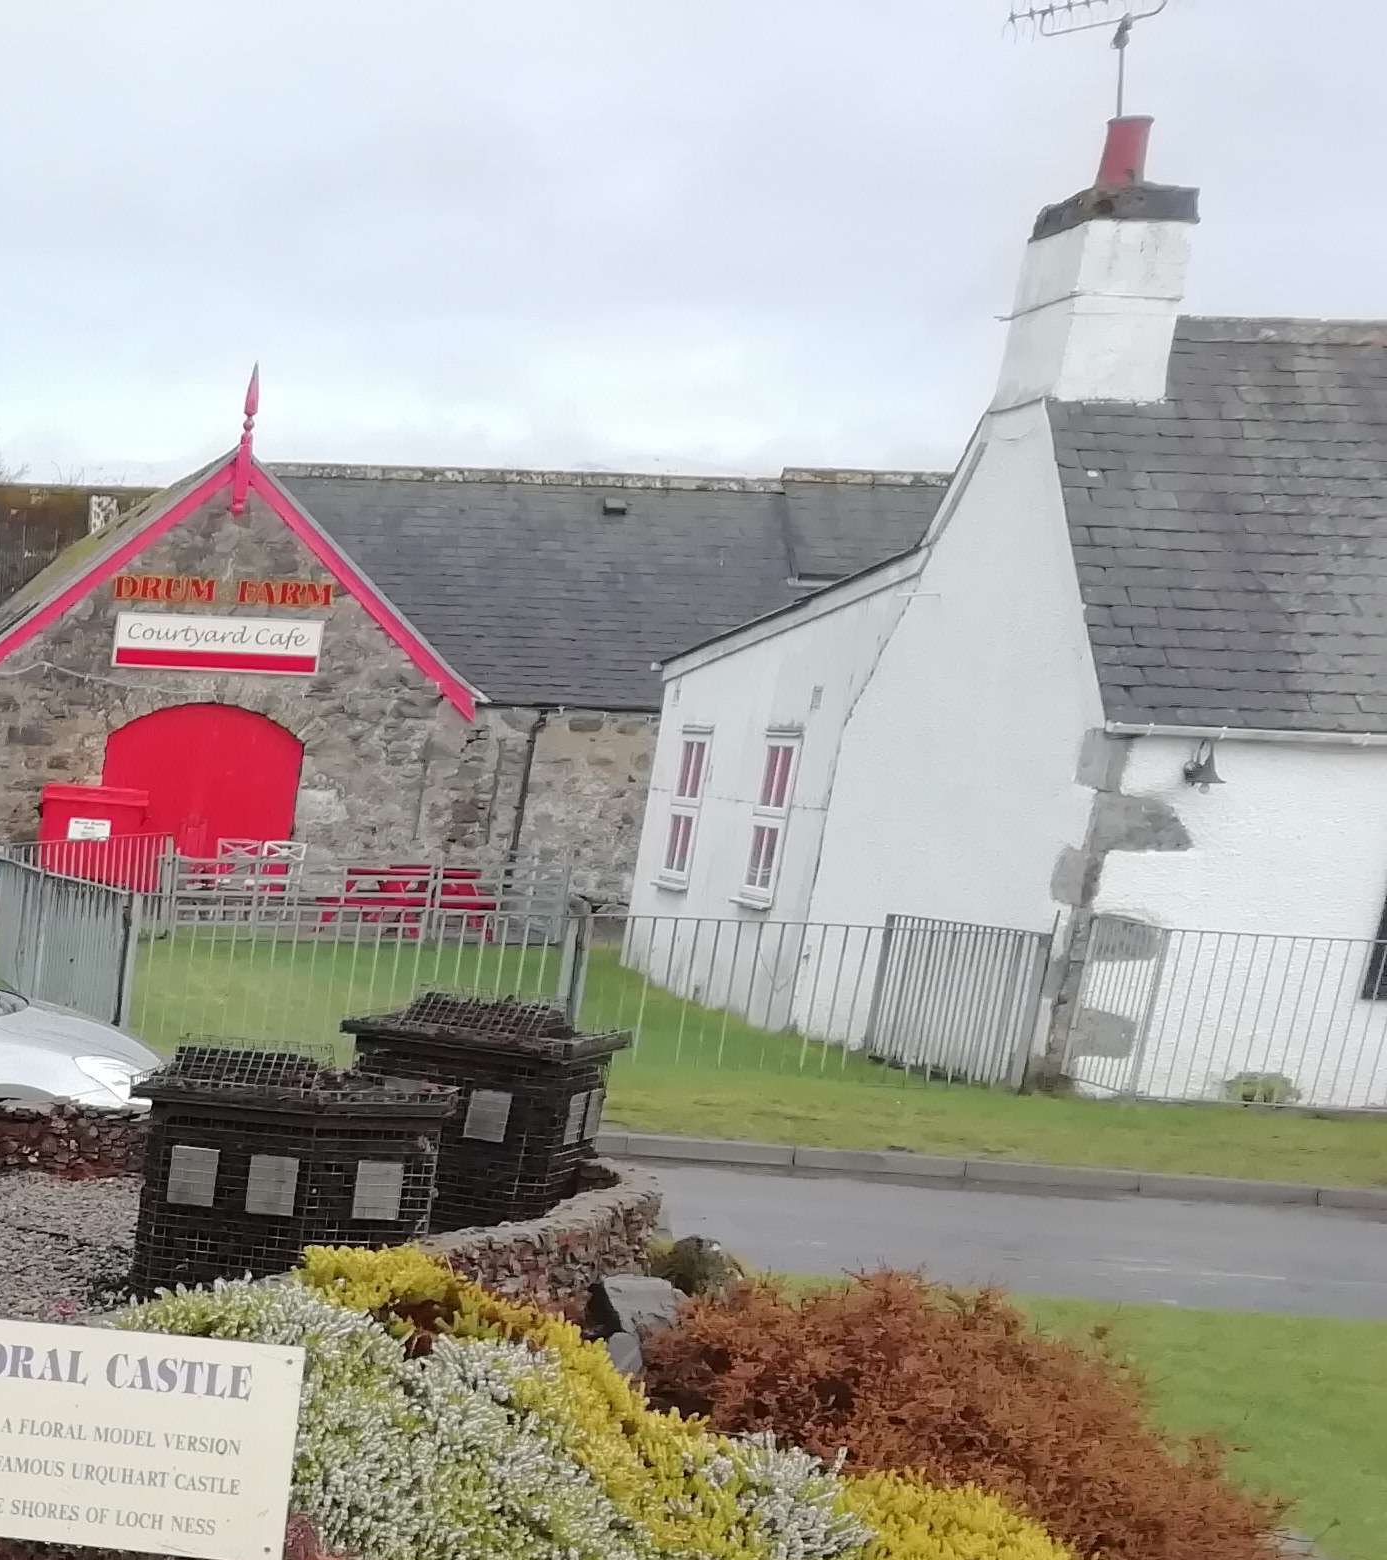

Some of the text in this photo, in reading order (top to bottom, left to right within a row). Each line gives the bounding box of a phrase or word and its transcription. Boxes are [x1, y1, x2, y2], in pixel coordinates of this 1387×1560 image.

[114, 575, 334, 607] DRUM FARM
[127, 622, 311, 650] Courtyard Cafe
[106, 1352, 253, 1401] CASTLE
[0, 1416, 13, 1433] A
[18, 1418, 87, 1441] FLORAL
[93, 1426, 156, 1449] MODEL
[164, 1433, 242, 1456] VERSION
[71, 1462, 168, 1490] URQUHART
[174, 1472, 241, 1496] CASTLE
[11, 1498, 80, 1523] SHORES
[86, 1506, 109, 1525] OF
[115, 1509, 164, 1532] LOCH
[170, 1516, 216, 1537] NESS
